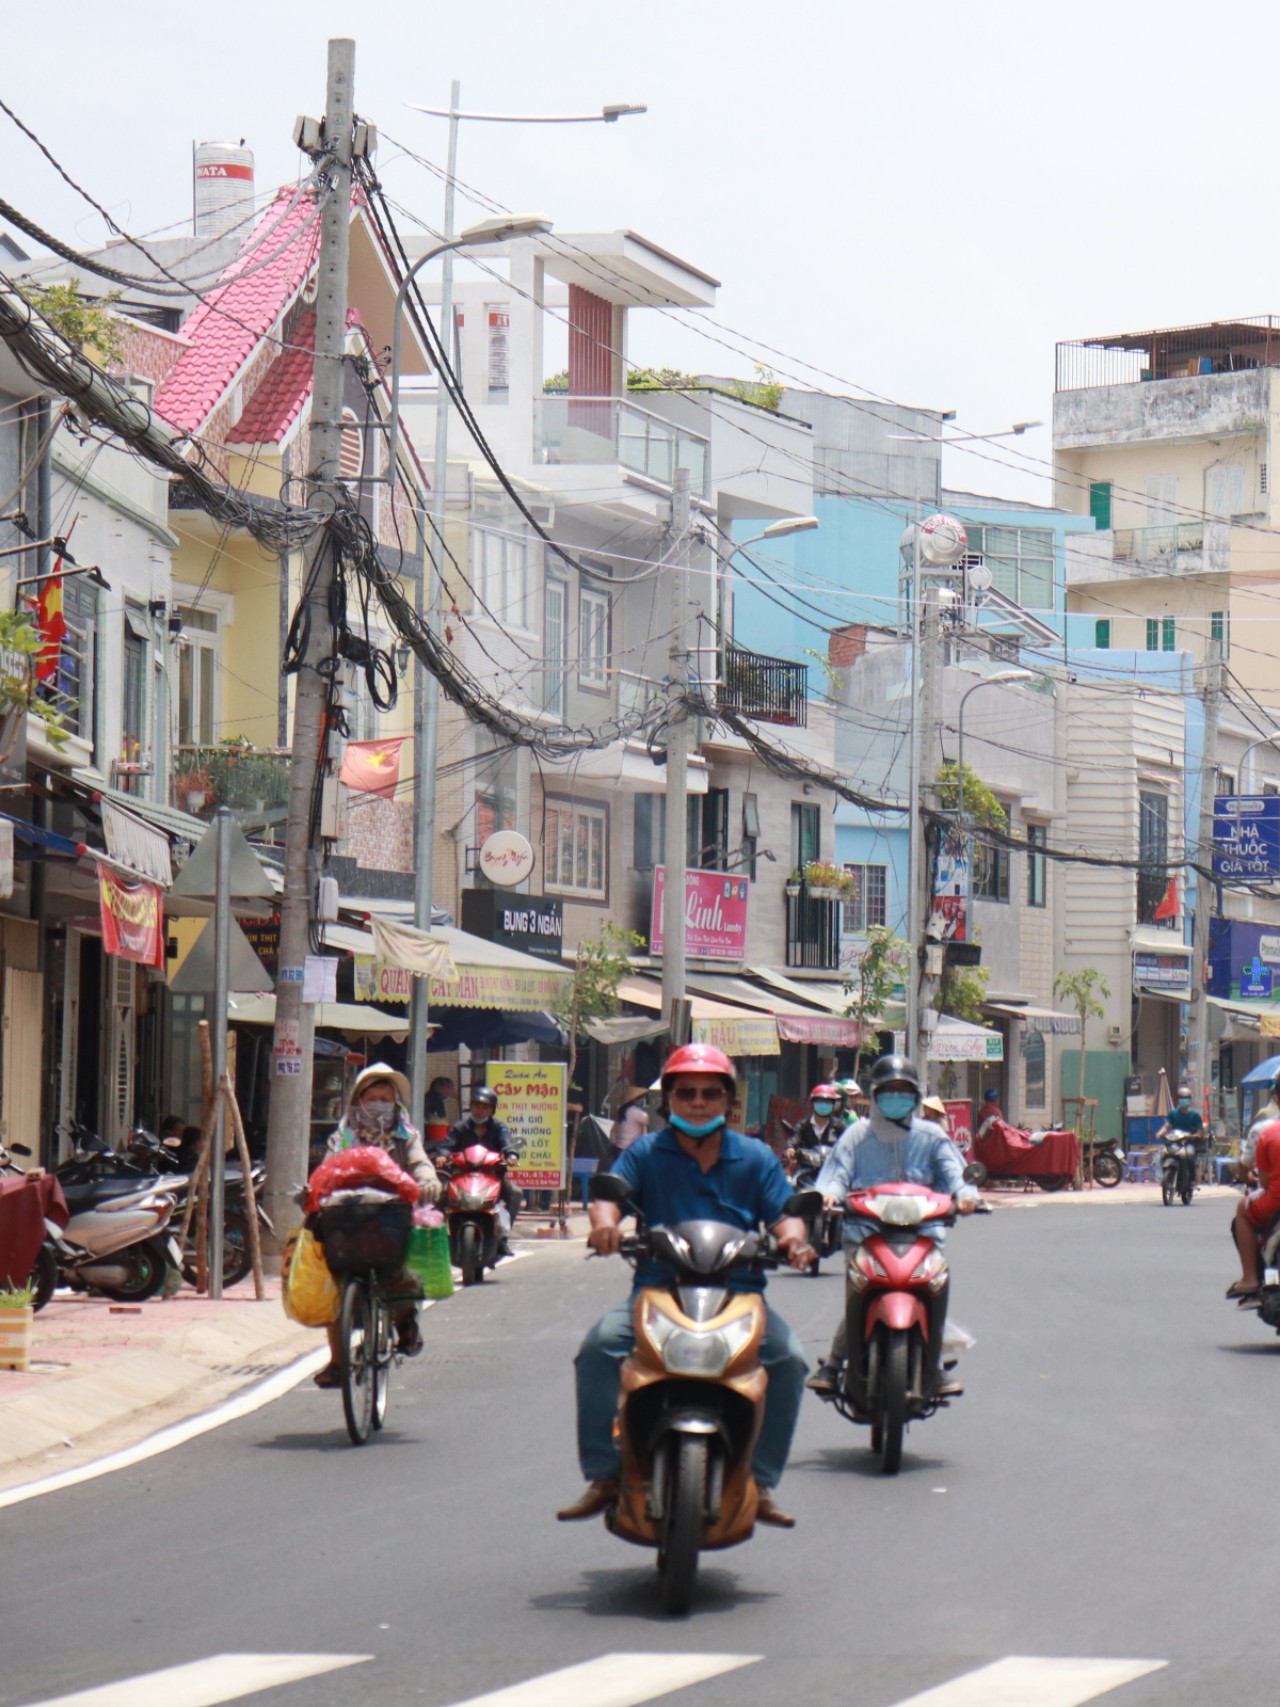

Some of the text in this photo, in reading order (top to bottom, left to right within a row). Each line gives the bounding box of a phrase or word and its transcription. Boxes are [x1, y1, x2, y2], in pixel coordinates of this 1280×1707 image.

[1231, 823, 1259, 838] NHÀ
[1222, 838, 1268, 855] THUỐC
[504, 909, 528, 936] BỤNG
[529, 910, 537, 935] 3
[494, 1083, 559, 1099] Cây Mận
